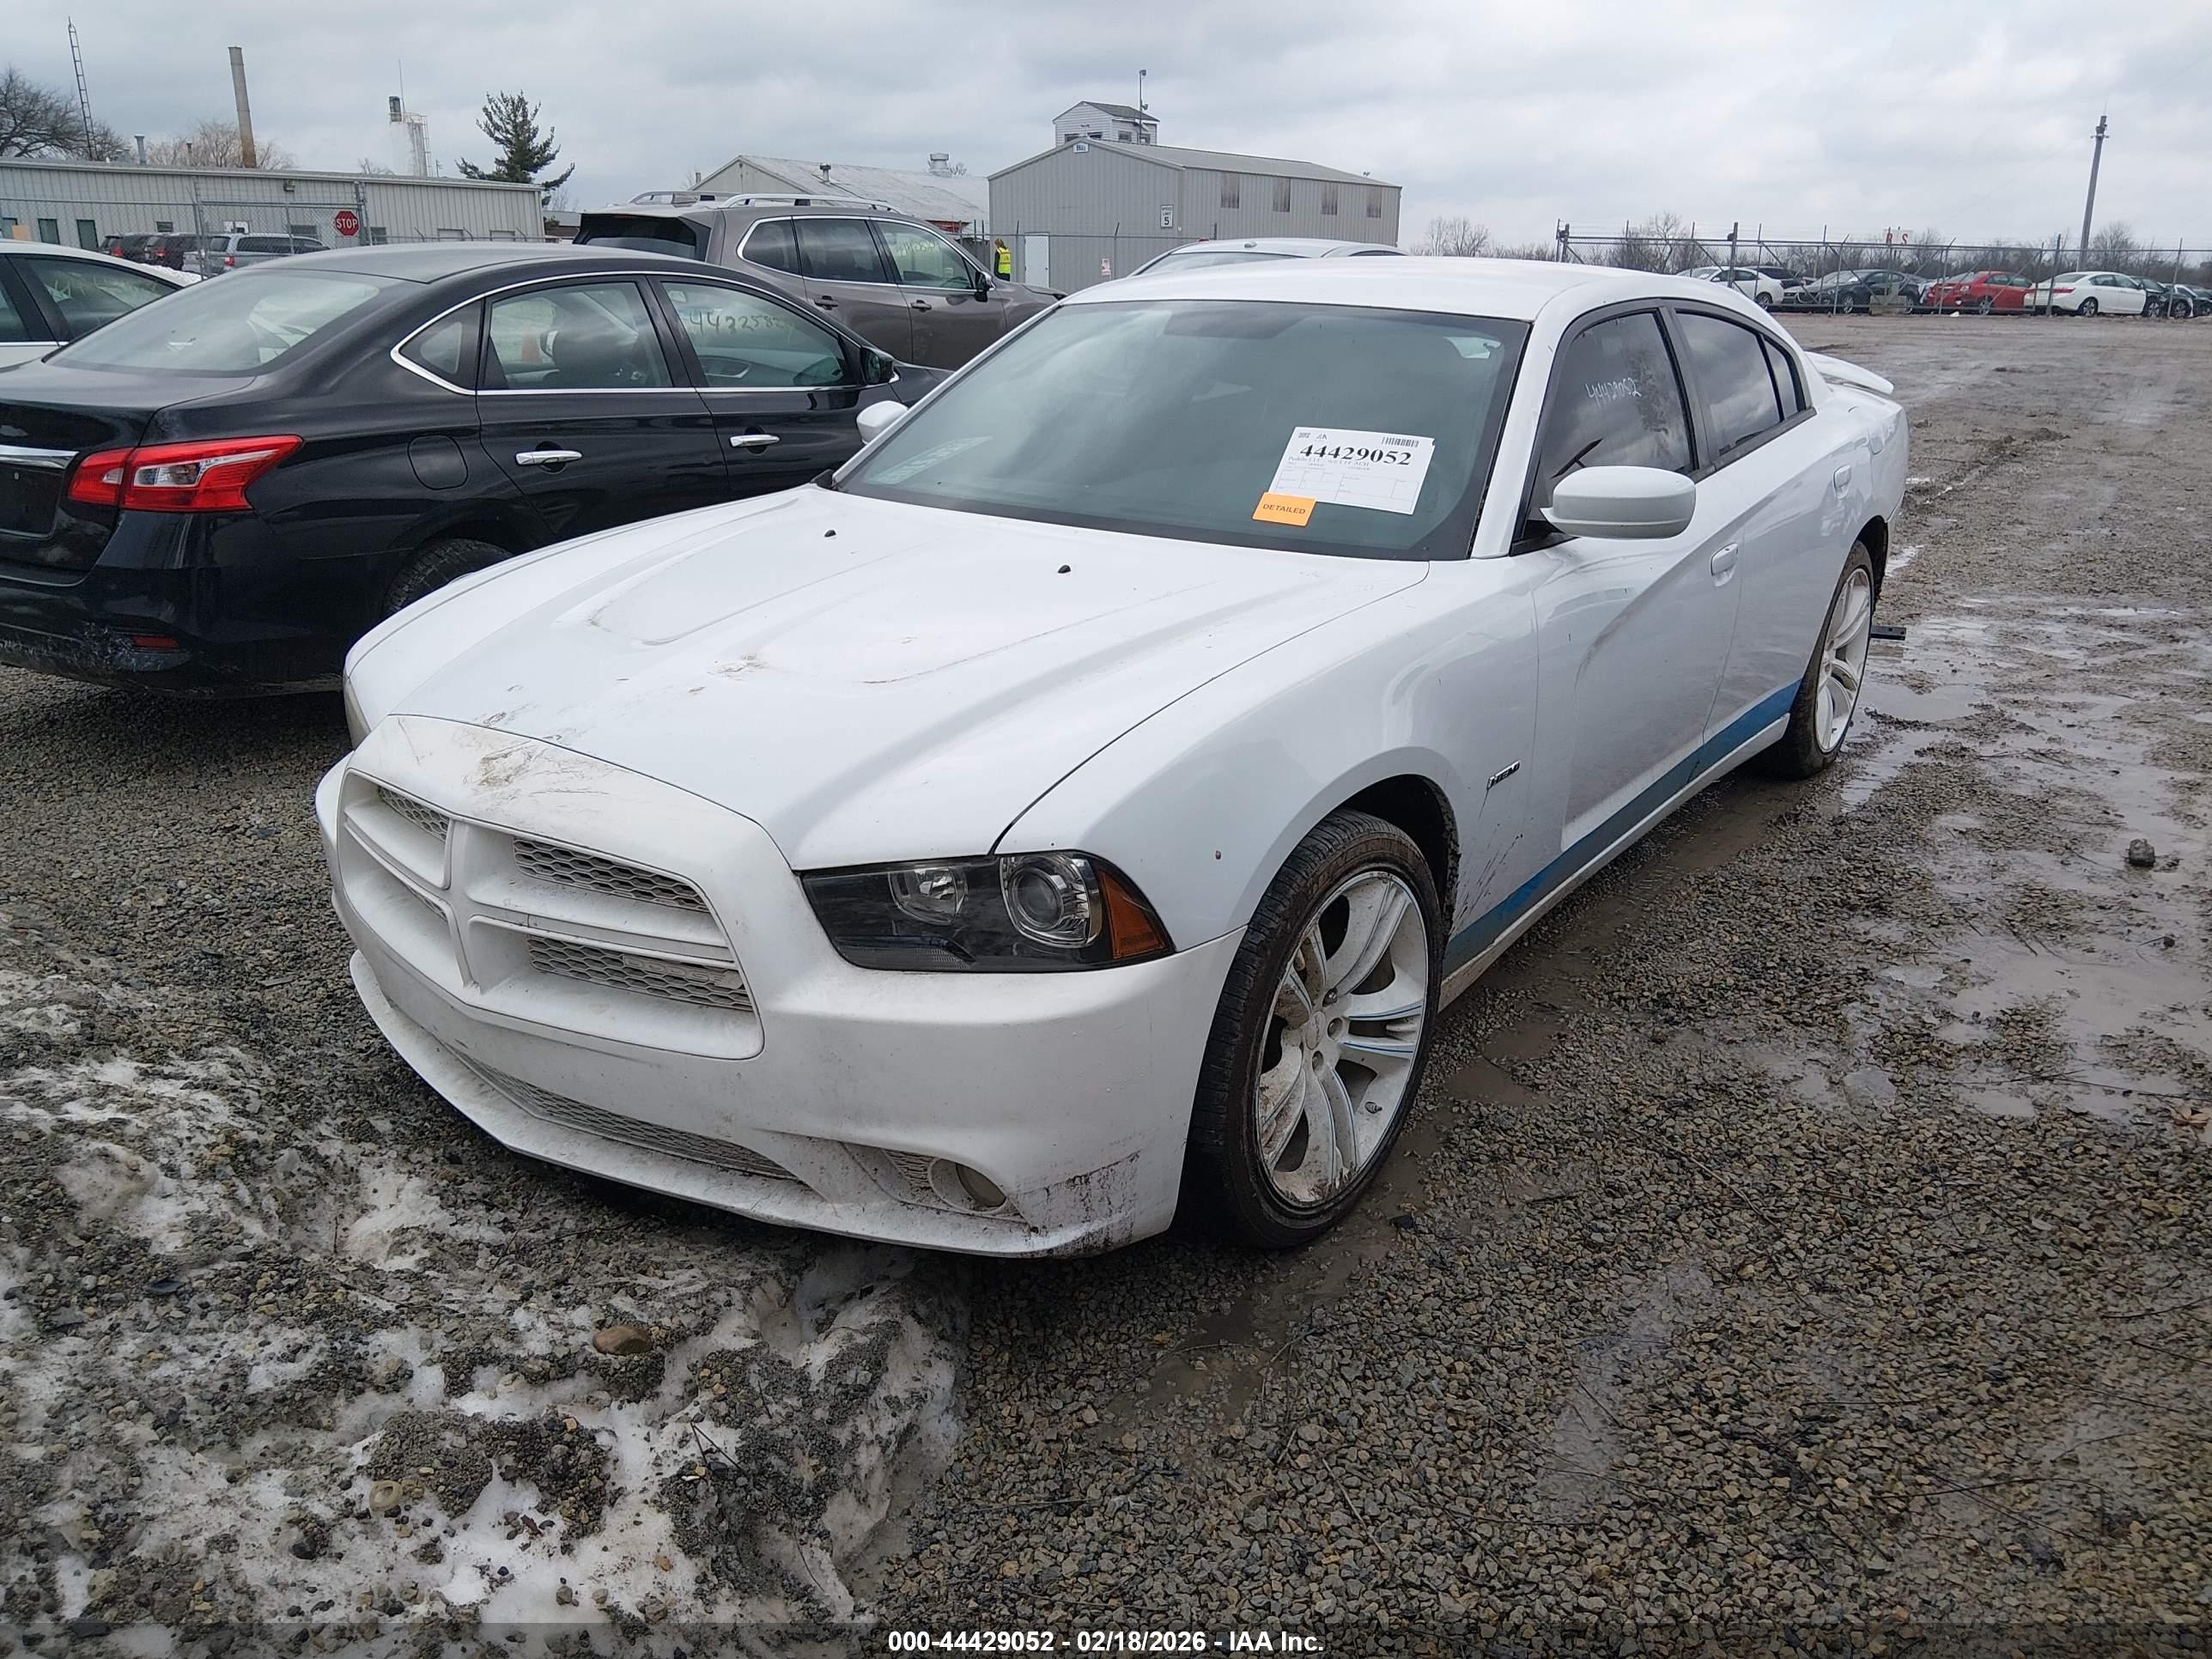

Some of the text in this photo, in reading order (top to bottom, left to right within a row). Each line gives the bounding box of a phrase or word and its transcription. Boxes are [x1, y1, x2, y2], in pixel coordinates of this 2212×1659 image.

[336, 218, 358, 229] STOP
[1164, 216, 1170, 225] 5
[1585, 377, 1642, 408] 44429052
[1299, 443, 1413, 465] 44429052
[1262, 503, 1306, 514] DETAILED
[623, 955, 725, 984] DODGE
